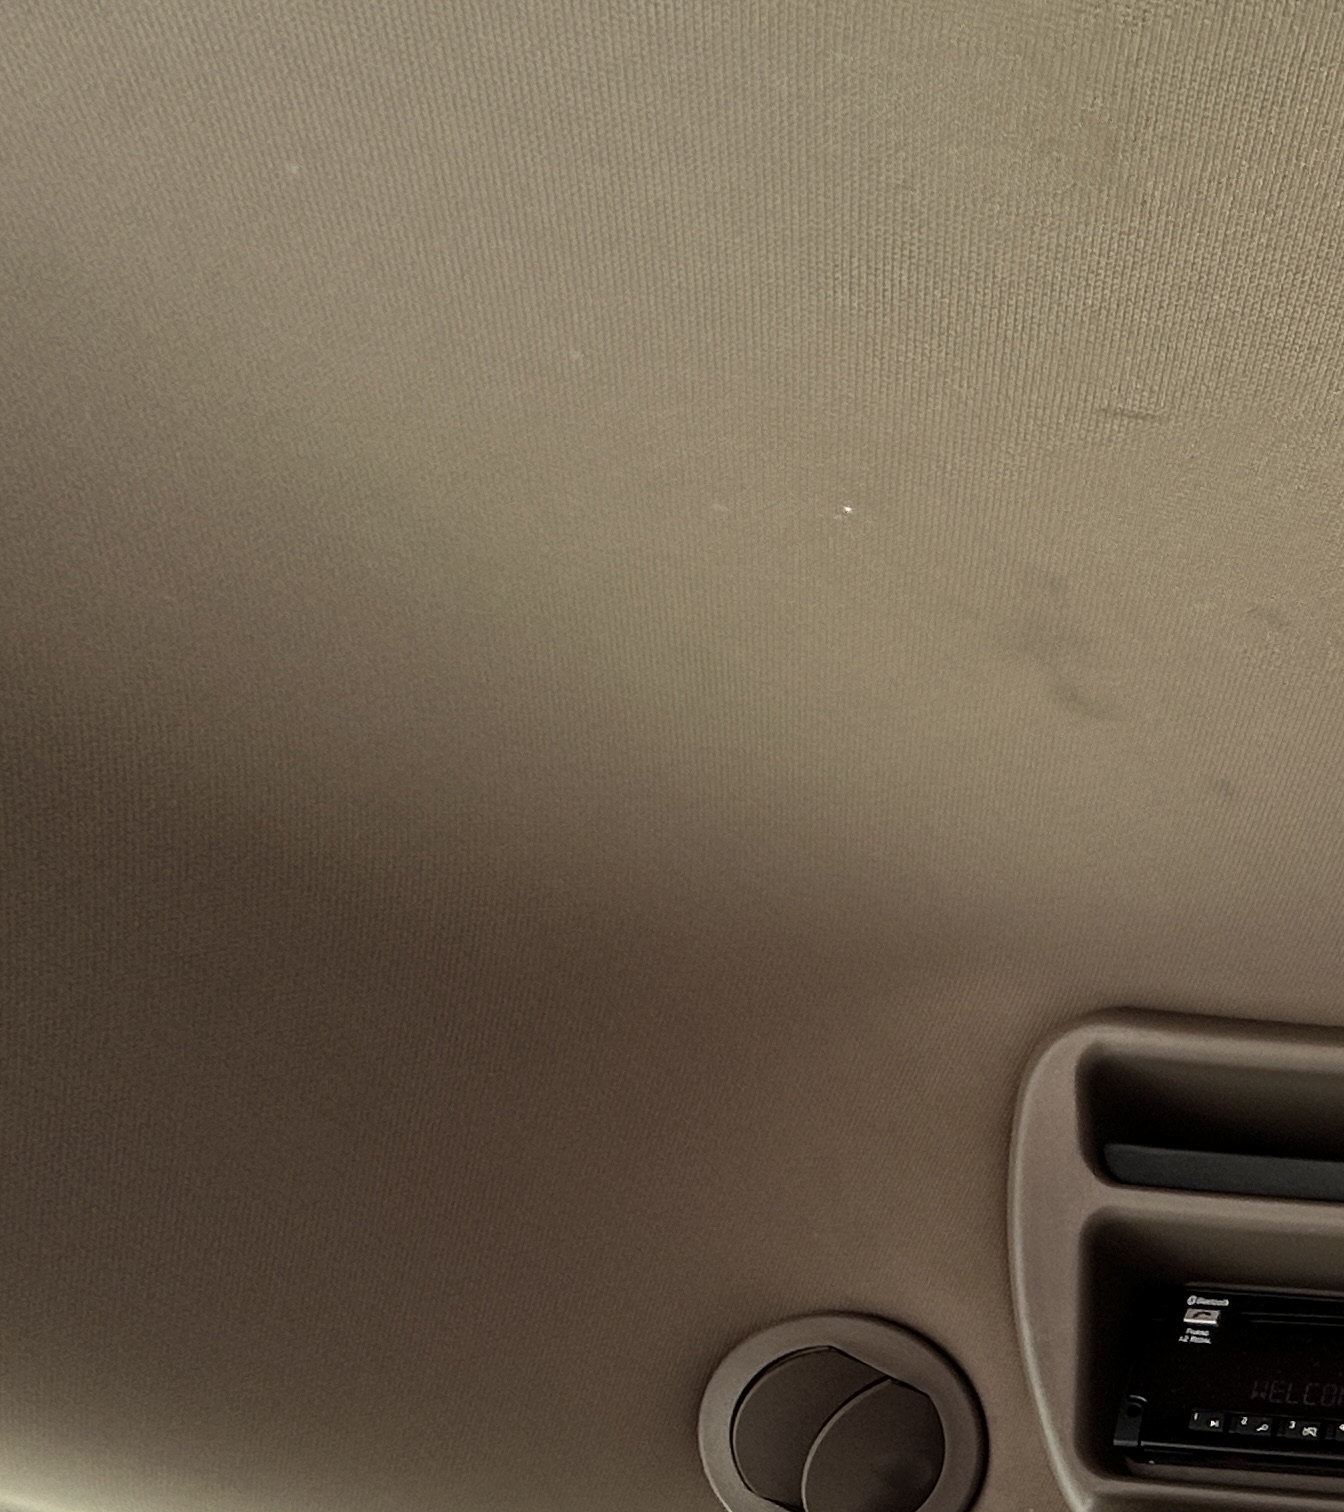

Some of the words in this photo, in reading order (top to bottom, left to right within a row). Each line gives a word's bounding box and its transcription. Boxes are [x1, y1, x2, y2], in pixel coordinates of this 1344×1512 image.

[1194, 1412, 1198, 1421] 1
[1241, 1416, 1248, 1425] 2
[1289, 1420, 1296, 1429] 3
